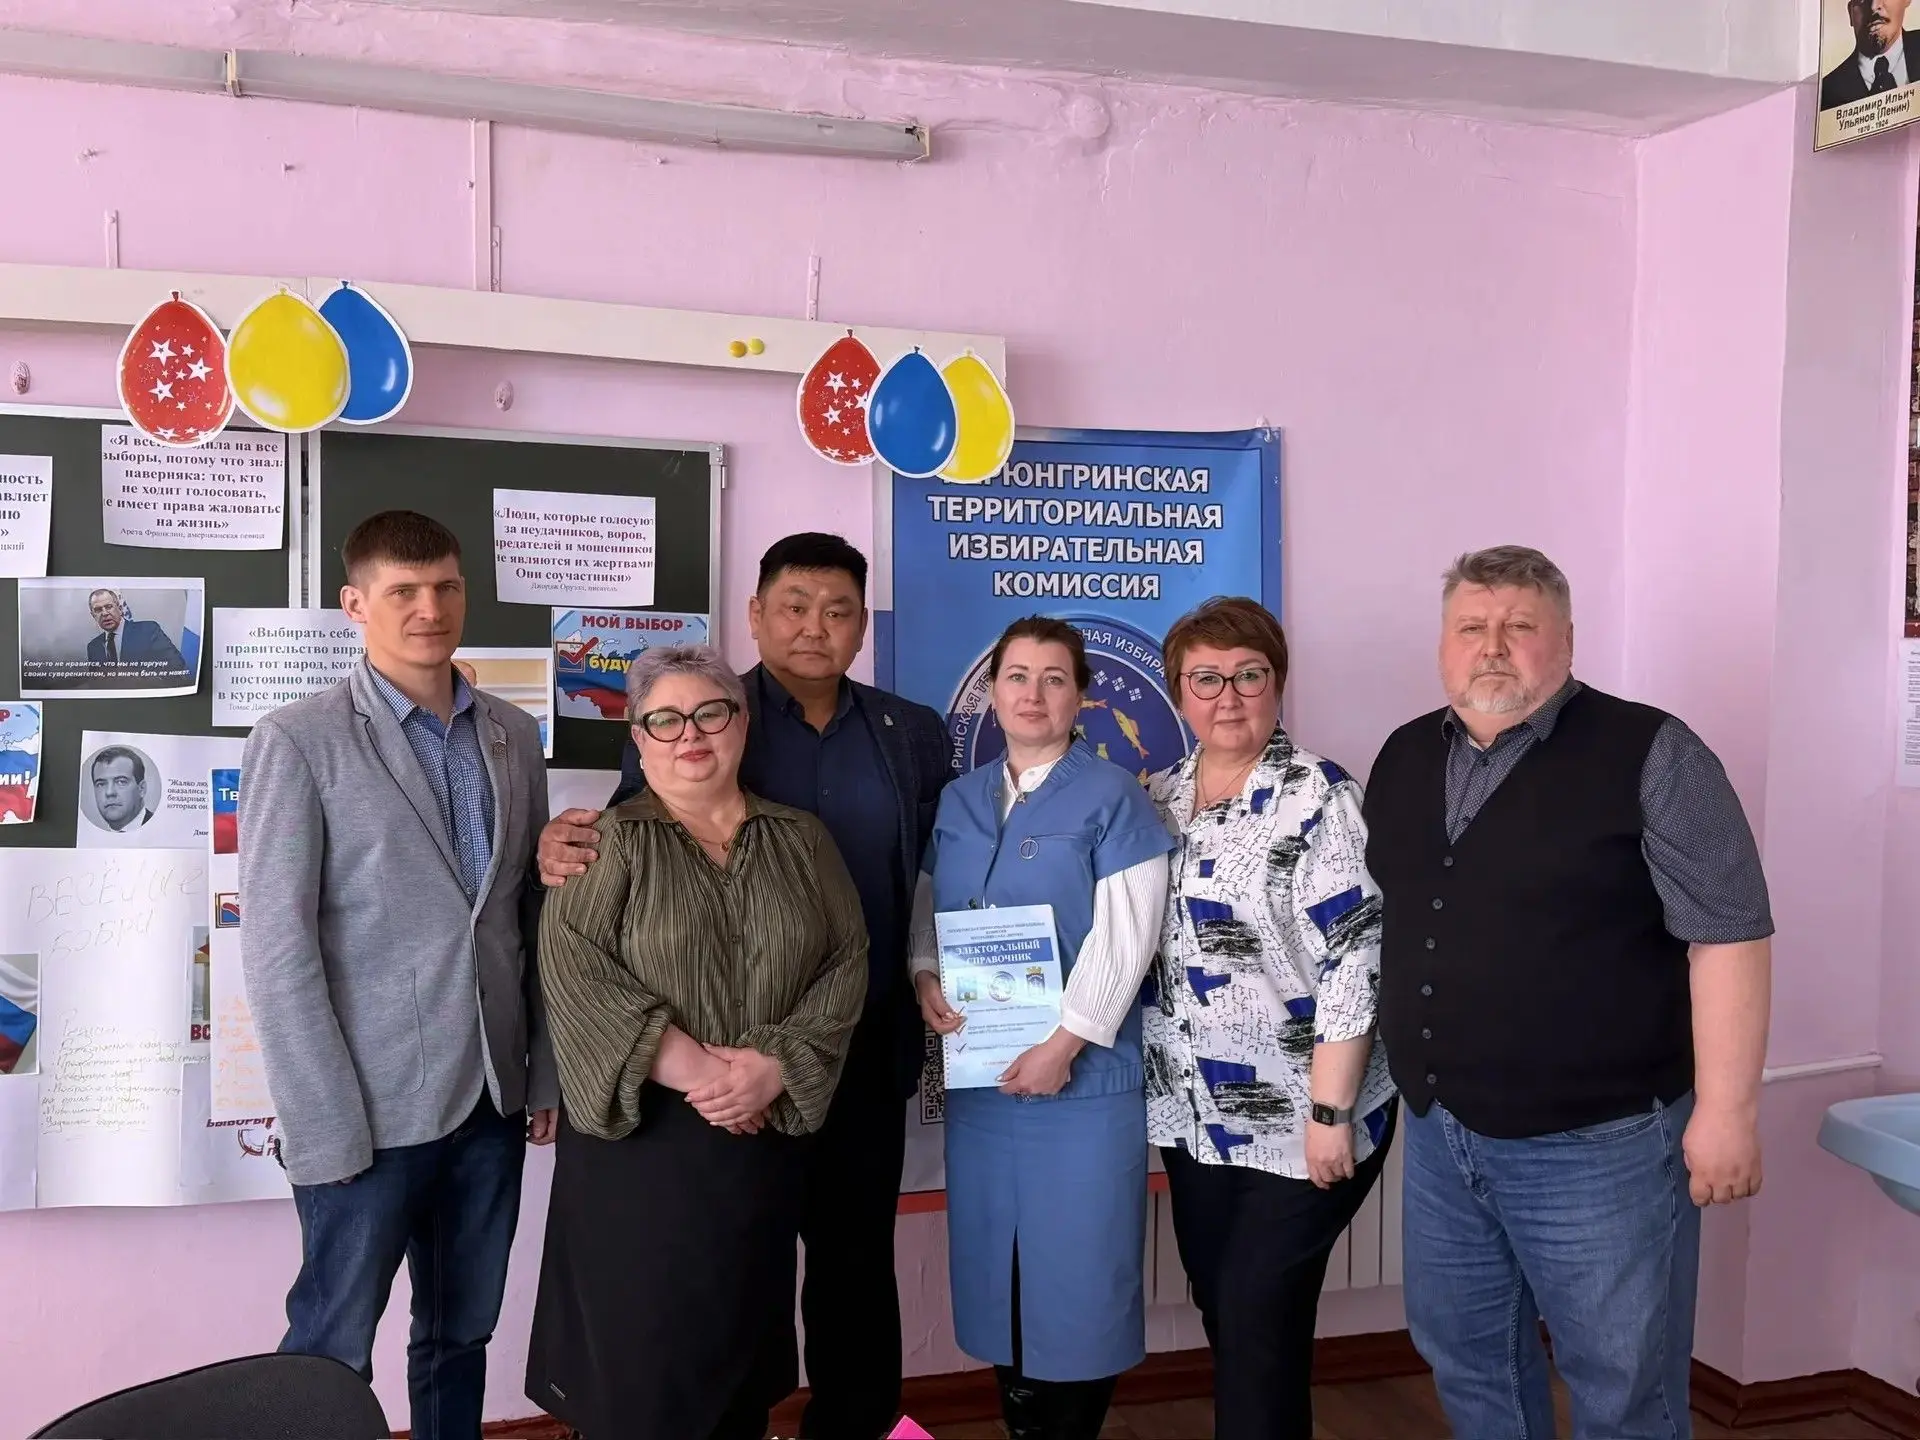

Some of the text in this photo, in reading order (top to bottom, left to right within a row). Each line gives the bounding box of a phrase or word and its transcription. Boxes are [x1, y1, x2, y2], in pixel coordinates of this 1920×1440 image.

[1836, 89, 1915, 120] Владимир Ильич
[1839, 99, 1910, 131] Ульянов (Ленин)
[110, 435, 128, 445] «Я
[236, 442, 251, 451] на
[256, 443, 278, 452] все
[166, 455, 216, 468] потому
[221, 457, 244, 466] что
[249, 458, 283, 467] знал
[125, 469, 263, 483] наверняка: тот, кто
[944, 460, 1209, 493] ЮНГРИНСКАЯ
[122, 485, 266, 499] не ходит голосовать,
[117, 500, 158, 510] имеет
[163, 502, 204, 514] права
[927, 495, 1223, 529] ТЕРРИТОРИАЛЬНАЯ
[495, 508, 540, 521] «Люди,
[544, 513, 596, 524] которые
[156, 518, 229, 529] на жизнь»
[504, 525, 646, 541] за неудачников, воров,
[949, 533, 1204, 564] ИЗБИРАТЕЛЬНАЯ
[510, 555, 571, 566] являются
[575, 559, 589, 567] их
[516, 568, 631, 583] Они соучастники»
[993, 570, 1160, 599] КОМИССИЯ
[581, 614, 620, 629] МОЙ
[625, 617, 684, 632] ВЫБОР
[249, 627, 357, 640] «Выбирать себе
[226, 645, 368, 657] правительство впра
[23, 660, 53, 669] Кому-то
[65, 661, 101, 669] нравится,
[140, 660, 168, 669] торгуем
[1115, 636, 1167, 681] ИЗБИРА
[214, 660, 253, 669] лишь
[259, 660, 280, 669] тот
[284, 660, 327, 672] народ,
[48, 671, 106, 679] суверенитетом,
[140, 669, 157, 677] быть
[231, 675, 303, 685] постоянно
[218, 691, 226, 700] в
[230, 691, 269, 703] курсе
[955, 938, 1041, 955] ЭЛЕКТОРАЛЬНЫЙ
[966, 952, 1032, 965] СПРАВОЧНИК
